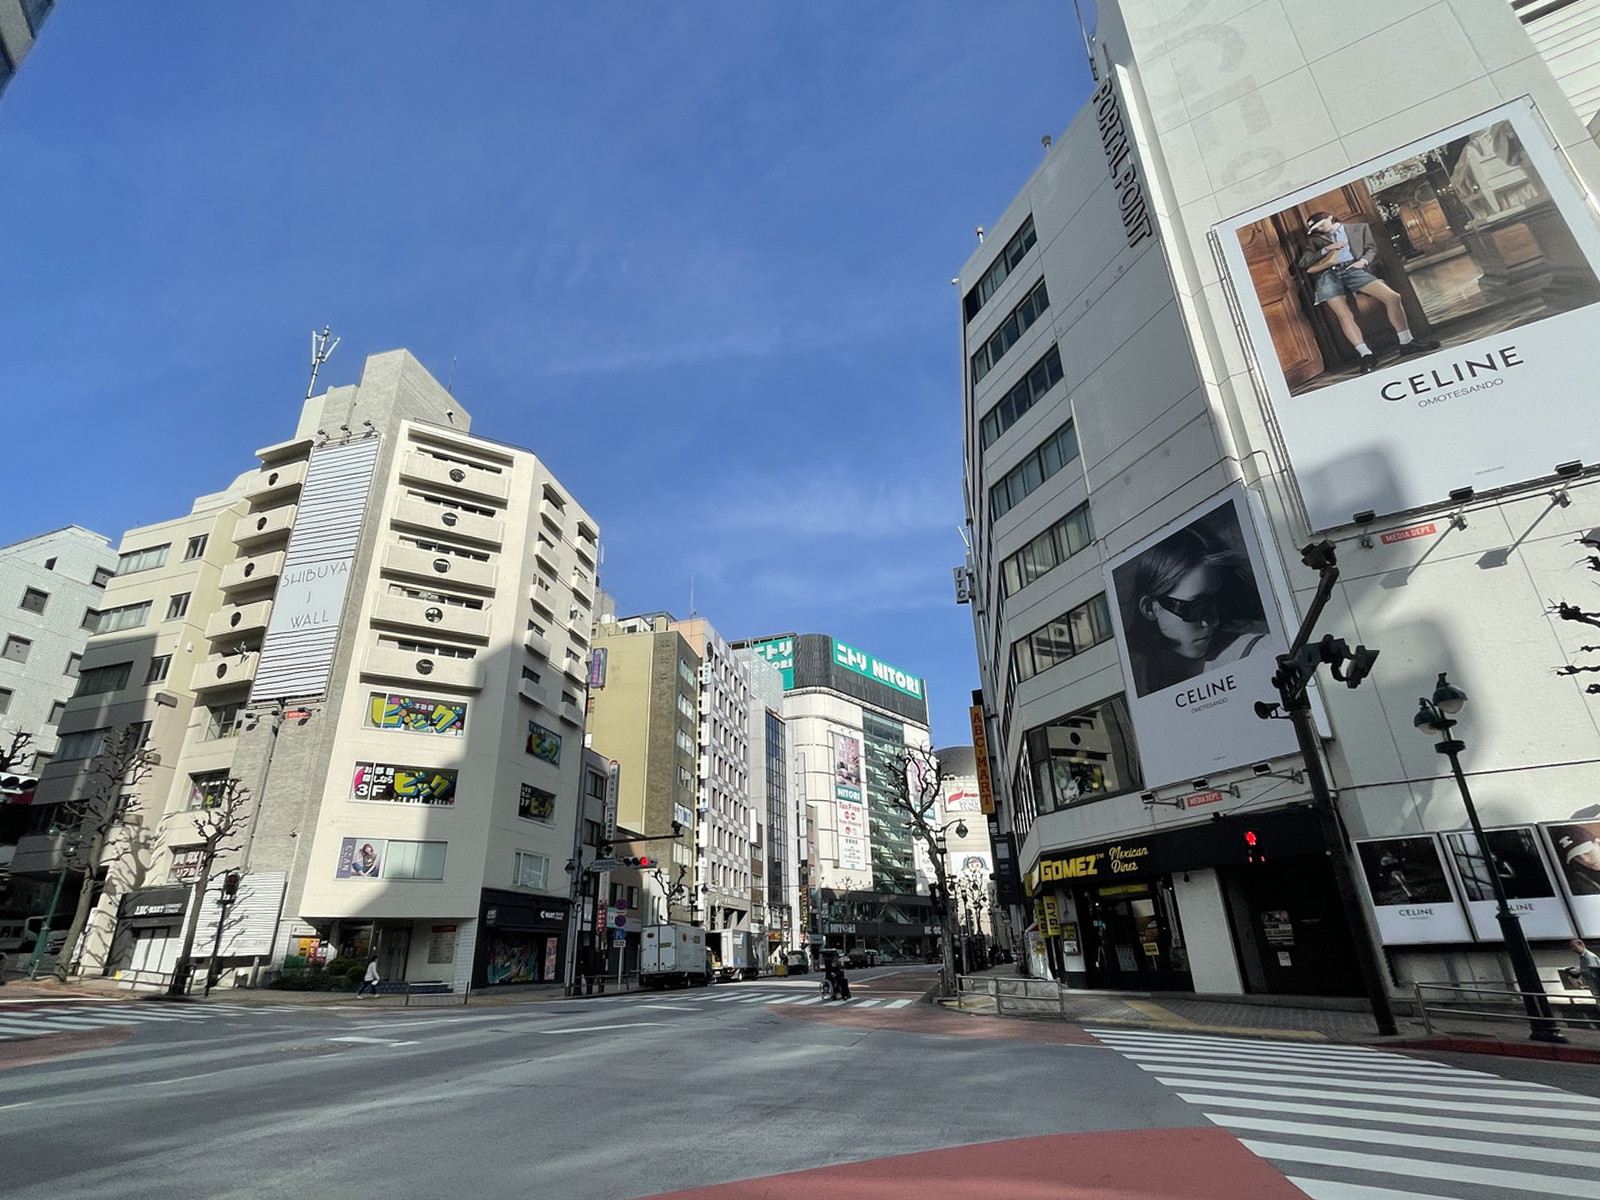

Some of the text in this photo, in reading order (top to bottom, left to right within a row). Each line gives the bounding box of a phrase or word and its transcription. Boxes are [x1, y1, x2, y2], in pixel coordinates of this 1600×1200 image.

[1093, 77, 1153, 248] PORTAL POINT
[1380, 346, 1524, 402] CELINE
[1418, 378, 1504, 408] OMOTESANDO
[1385, 528, 1410, 543] MEDIA
[282, 561, 347, 588] SHIBUYA
[957, 570, 966, 599] ITC
[290, 609, 329, 629] WALL
[753, 640, 793, 661] ニトリ
[837, 643, 919, 695] ニトリ NITORI
[1175, 674, 1237, 708] CELINE
[372, 697, 463, 733] ビッグ
[356, 784, 386, 797] 3F
[394, 771, 455, 797] ビッグ
[1109, 846, 1149, 860] Mexican
[1040, 854, 1098, 882] GOMEZ
[1111, 859, 1138, 874] Diner
[1399, 908, 1435, 916] CELINE
[1496, 902, 1535, 912] CLINE
